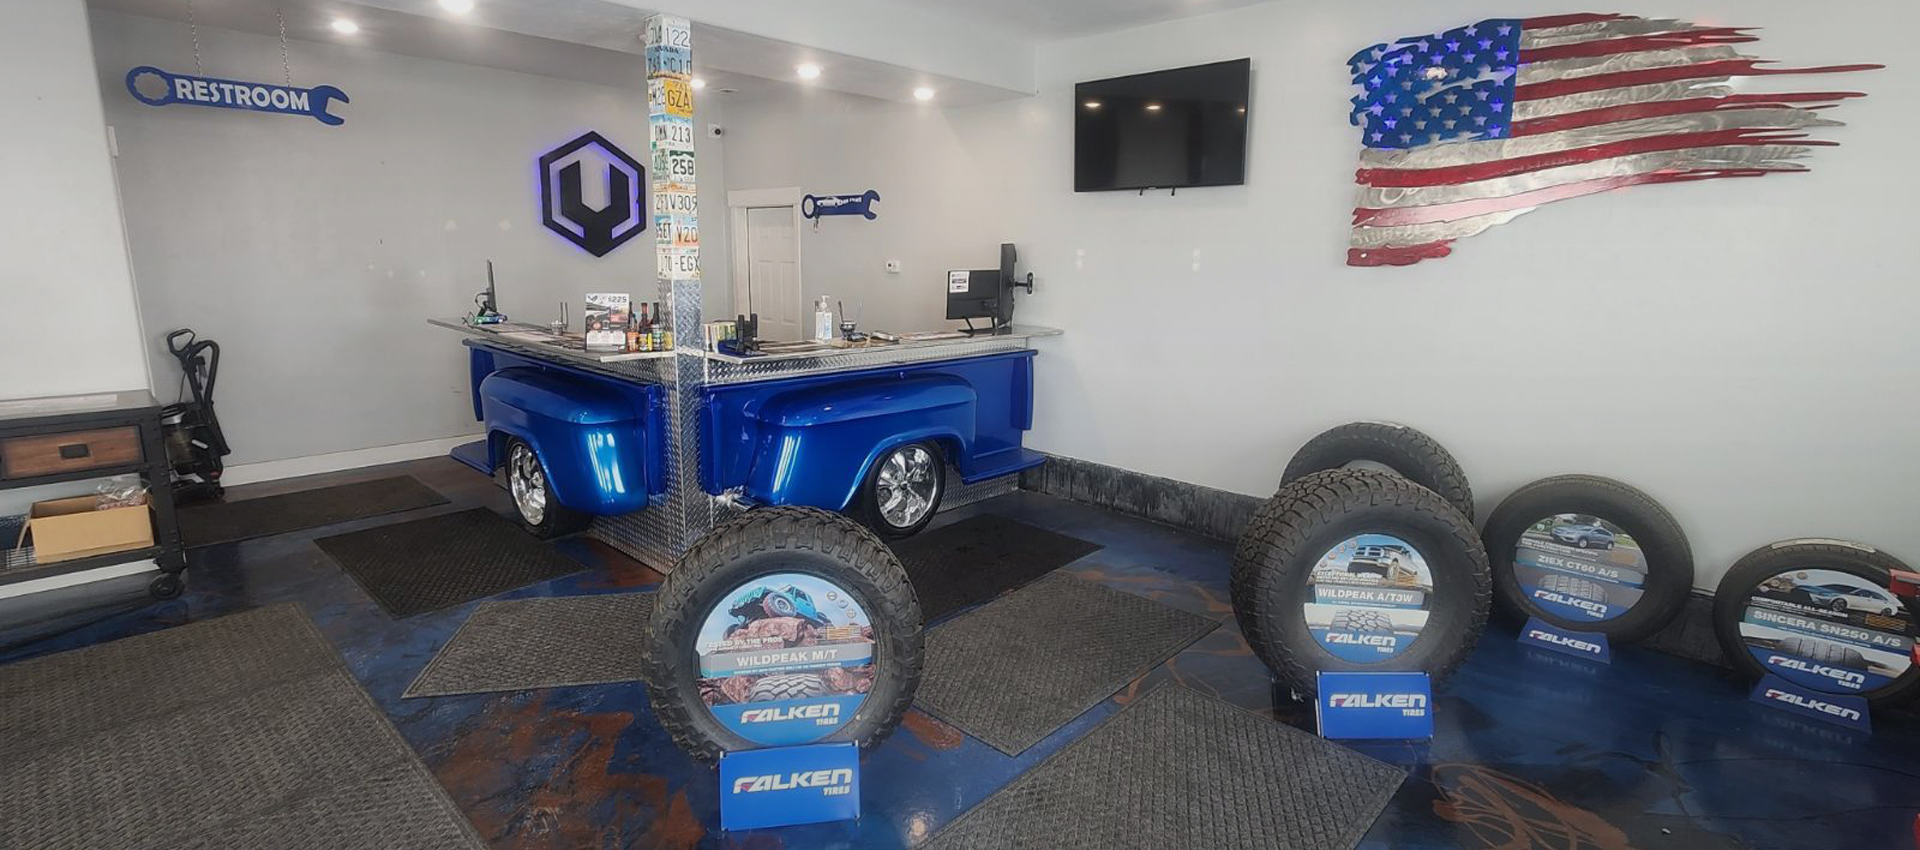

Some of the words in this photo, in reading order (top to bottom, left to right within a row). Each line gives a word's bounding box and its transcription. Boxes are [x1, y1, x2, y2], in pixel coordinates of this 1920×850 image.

[174, 78, 310, 111] RESTROOM
[671, 125, 691, 144] 213
[1538, 554, 1564, 567] ZIEX
[1566, 561, 1596, 573] CT60
[1598, 567, 1619, 579] A/S
[1318, 588, 1375, 601] WILDPEAK
[1376, 592, 1413, 603] A/T3W
[1534, 589, 1608, 613] FALKEN
[1586, 610, 1604, 619] TIRES
[1753, 610, 1816, 631] SINCERA
[1820, 623, 1869, 641] SN250
[1872, 635, 1902, 647] A/S
[1325, 632, 1397, 646] FALKEN
[1529, 629, 1601, 654] FALKEN
[737, 652, 808, 667] WILDPEAK
[812, 649, 838, 660] M/T
[1768, 655, 1865, 684] FALKEN
[1838, 680, 1861, 690] TIRES
[1329, 693, 1426, 708] FALKEN
[1765, 689, 1861, 721] FALKEN
[740, 703, 840, 724] FALKEN
[816, 717, 838, 726] TIRES
[1402, 708, 1425, 717] TIRES
[733, 768, 852, 794] FALKEN
[823, 785, 850, 796] TIRES
